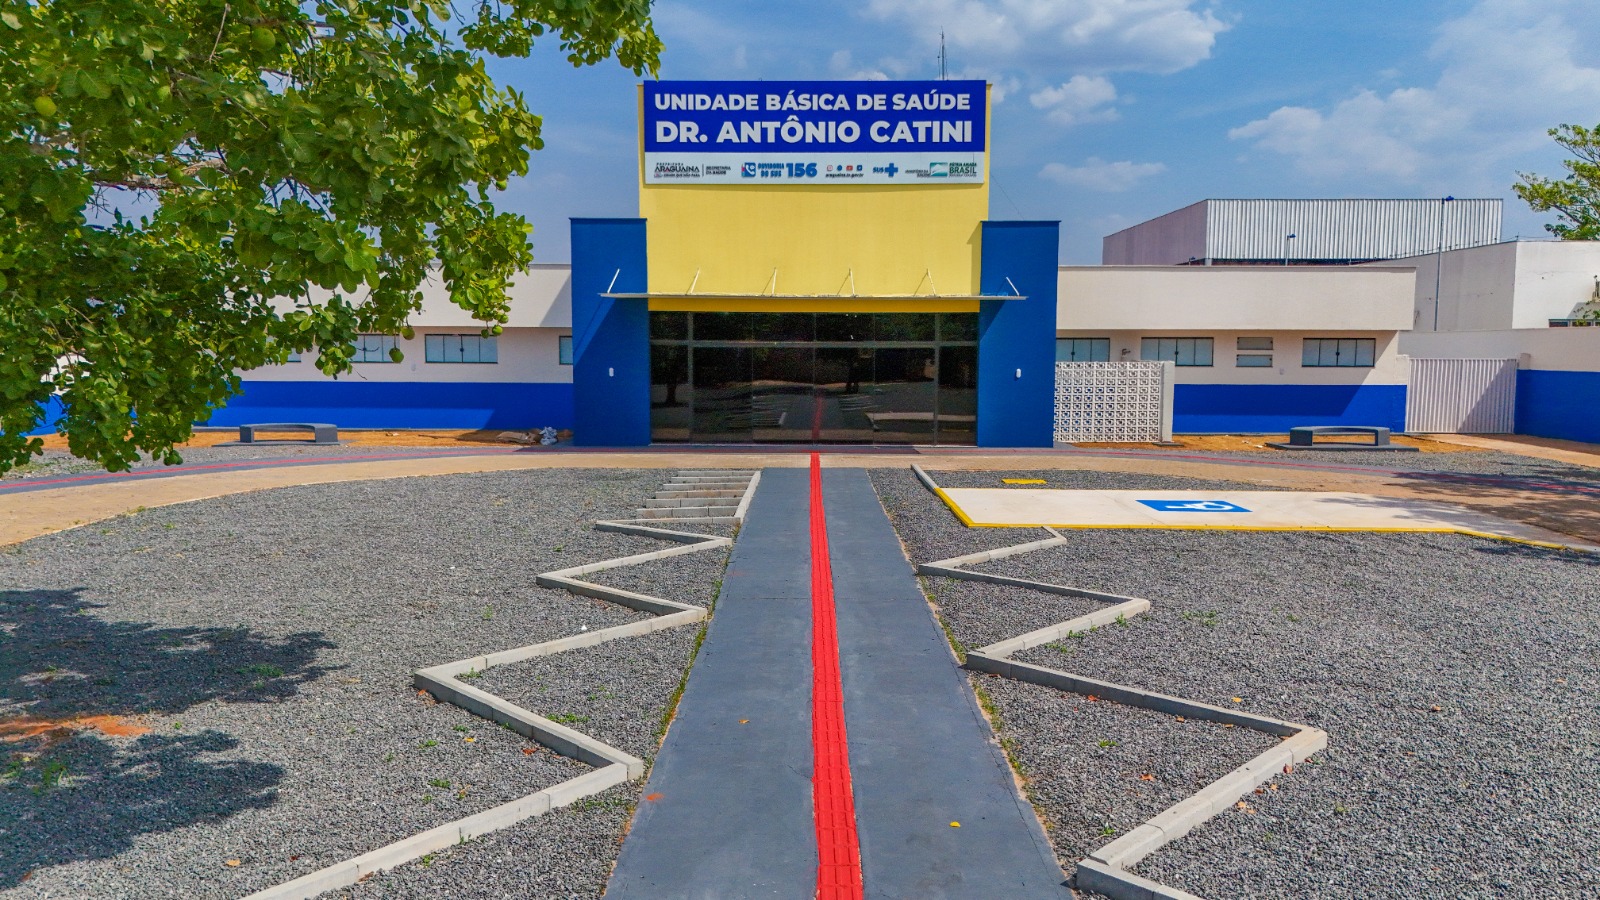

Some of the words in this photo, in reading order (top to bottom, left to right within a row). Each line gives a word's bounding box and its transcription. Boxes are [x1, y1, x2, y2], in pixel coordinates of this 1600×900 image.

[655, 93, 760, 111] UNIDADE
[766, 89, 850, 111] BÁSICA
[856, 93, 888, 111] DE
[892, 89, 971, 111] SAÚDE
[655, 120, 708, 144] DR.
[715, 115, 862, 144] ANTÔNIO
[869, 120, 973, 144] CATINI
[786, 162, 818, 178] 156
